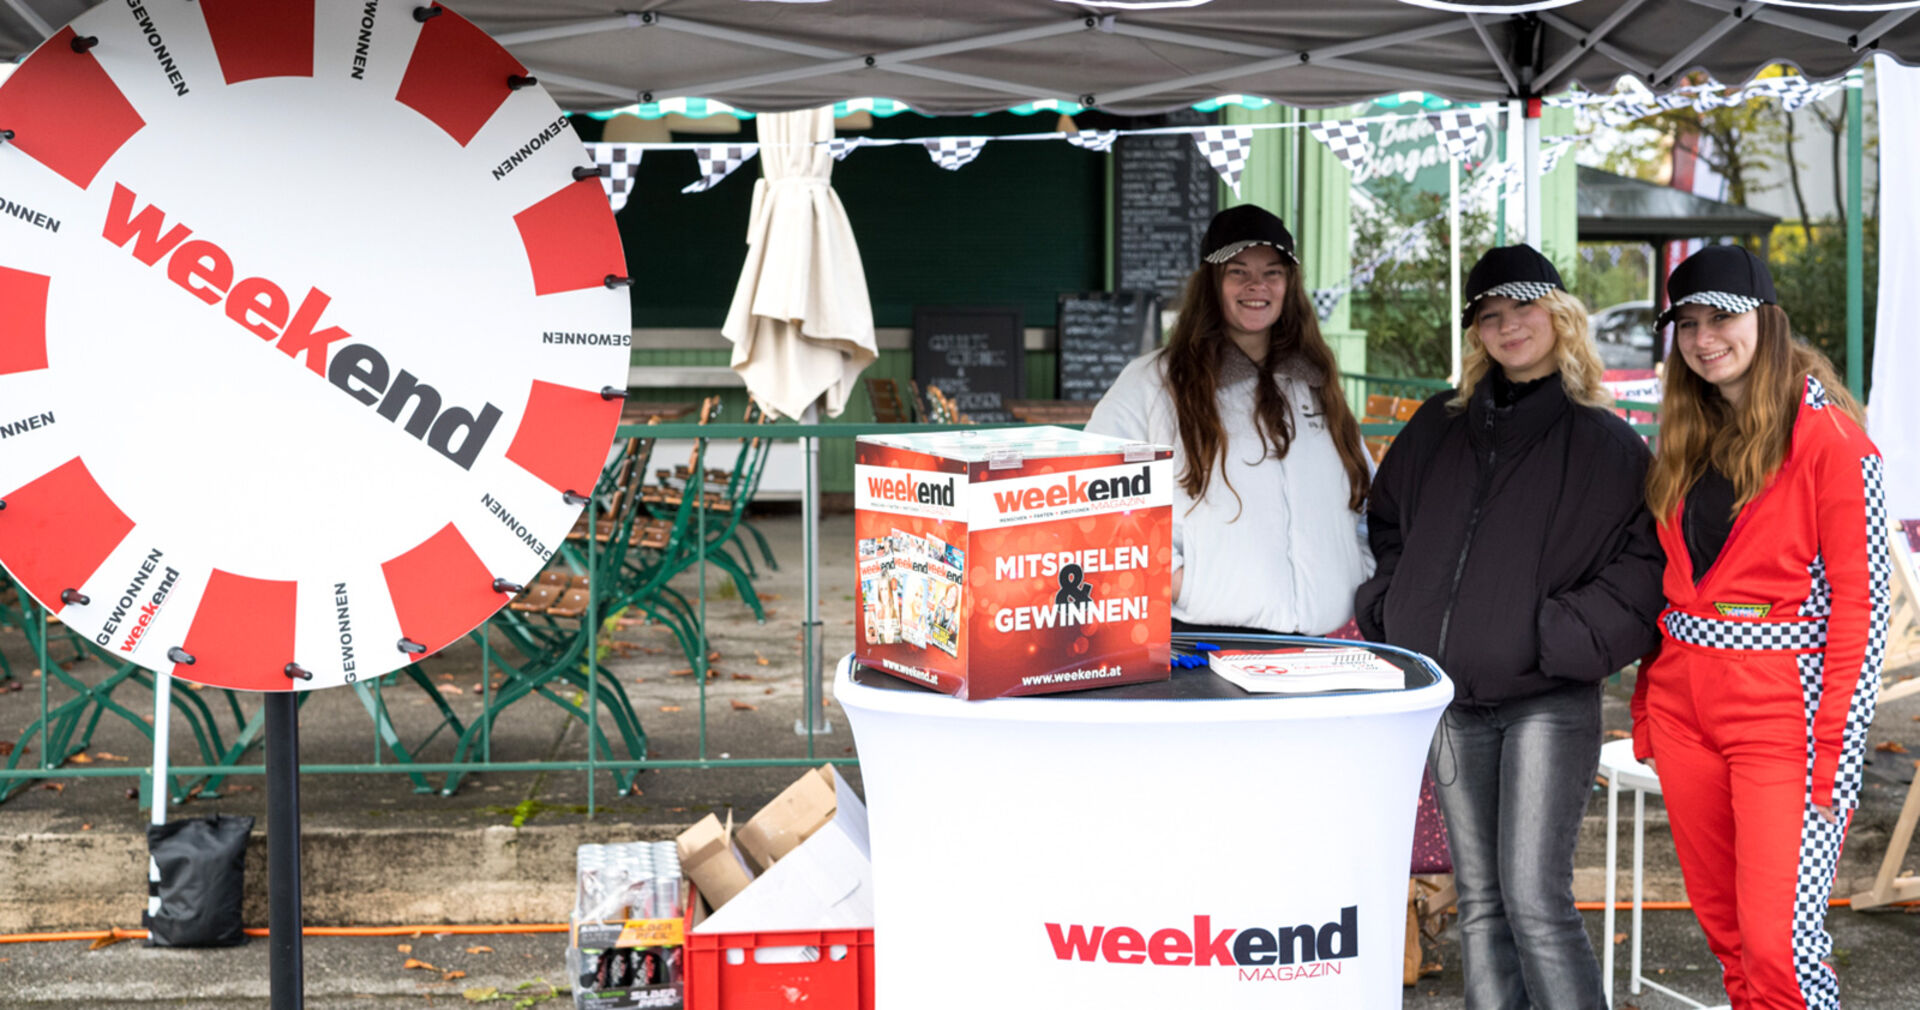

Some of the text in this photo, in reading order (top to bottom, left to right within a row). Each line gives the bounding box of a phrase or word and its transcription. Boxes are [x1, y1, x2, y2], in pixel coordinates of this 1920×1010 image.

[351, 0, 379, 80] WONNEN
[492, 115, 570, 181] GEWONNEN
[102, 181, 503, 471] weekend
[542, 331, 632, 347] GEWONNEN
[0, 410, 56, 440] NNEN
[867, 472, 955, 508] weekend
[993, 465, 1151, 513] weekend
[1091, 497, 1146, 512] MAGAZIN
[480, 492, 554, 563] GEWONNEN
[96, 548, 164, 646] GEWONNEN
[1055, 563, 1093, 605] &
[120, 566, 180, 652] weekend
[334, 582, 357, 684] GEWONNEN
[994, 596, 1149, 633] GEWINNEN!
[1021, 665, 1122, 687] www.weekend.at
[1044, 905, 1359, 967] weekend
[1238, 961, 1342, 982] MAGAZIN
